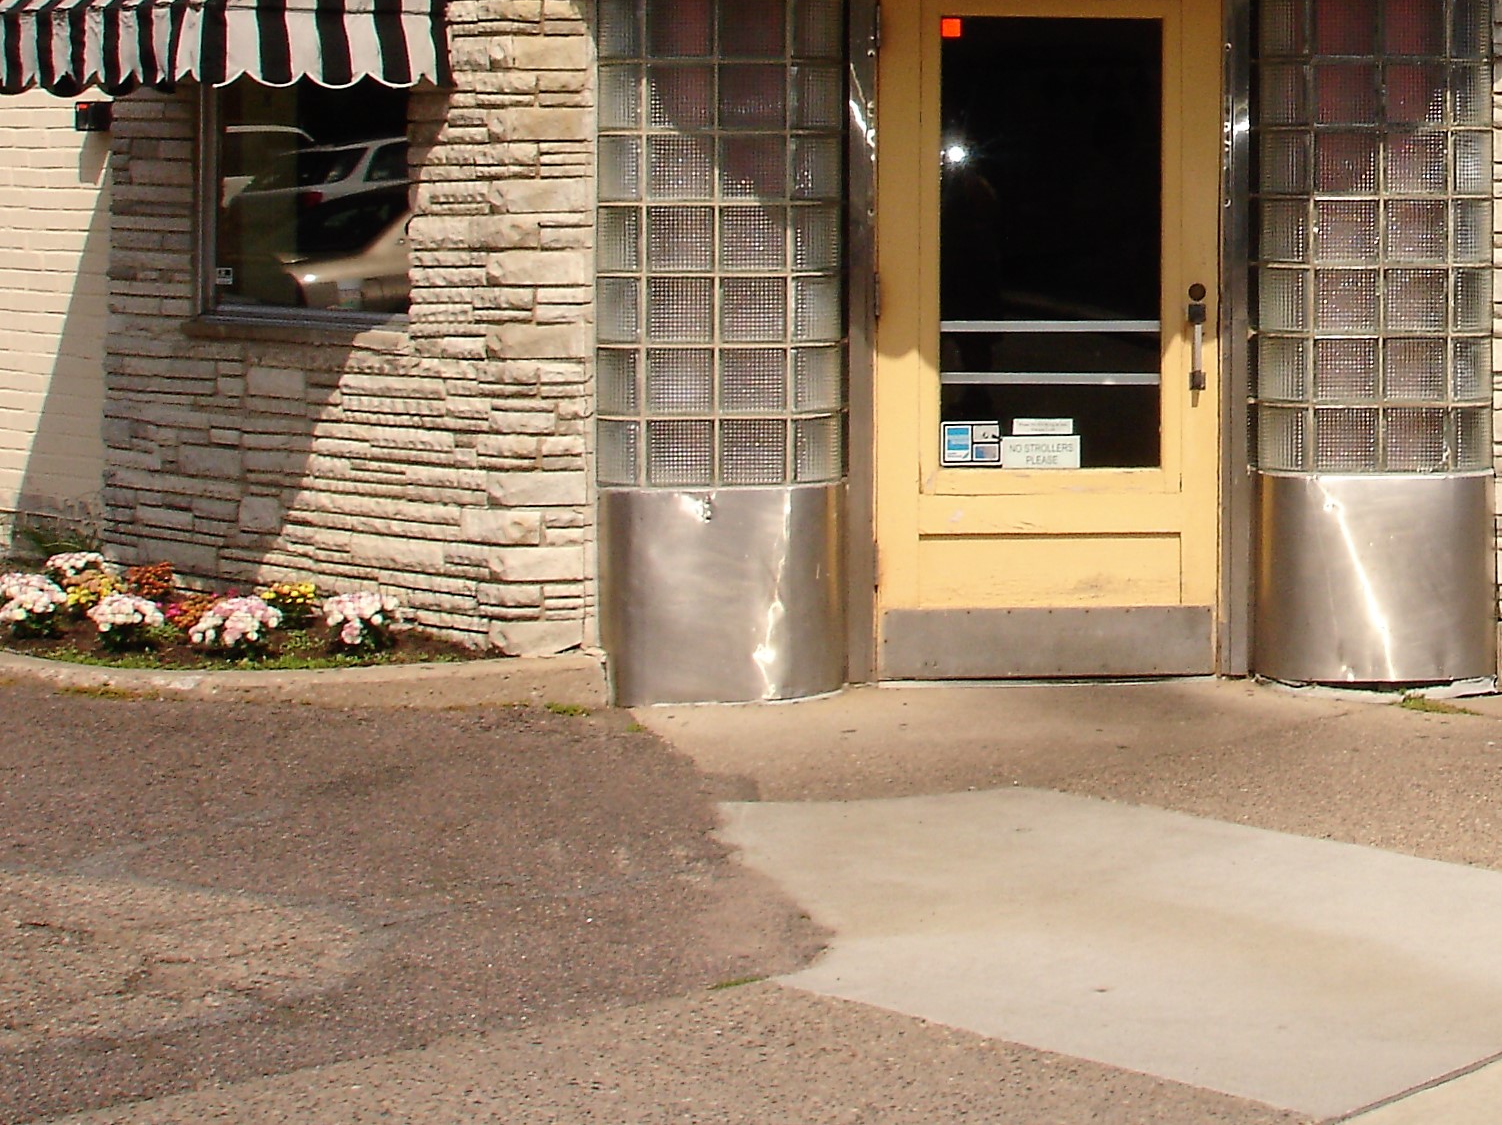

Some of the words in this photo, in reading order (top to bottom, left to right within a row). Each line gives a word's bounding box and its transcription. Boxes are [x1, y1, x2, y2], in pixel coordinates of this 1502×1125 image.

[1009, 443, 1022, 453] NO
[1025, 443, 1073, 453] STROLLERS
[1026, 455, 1058, 465] PLEASE
